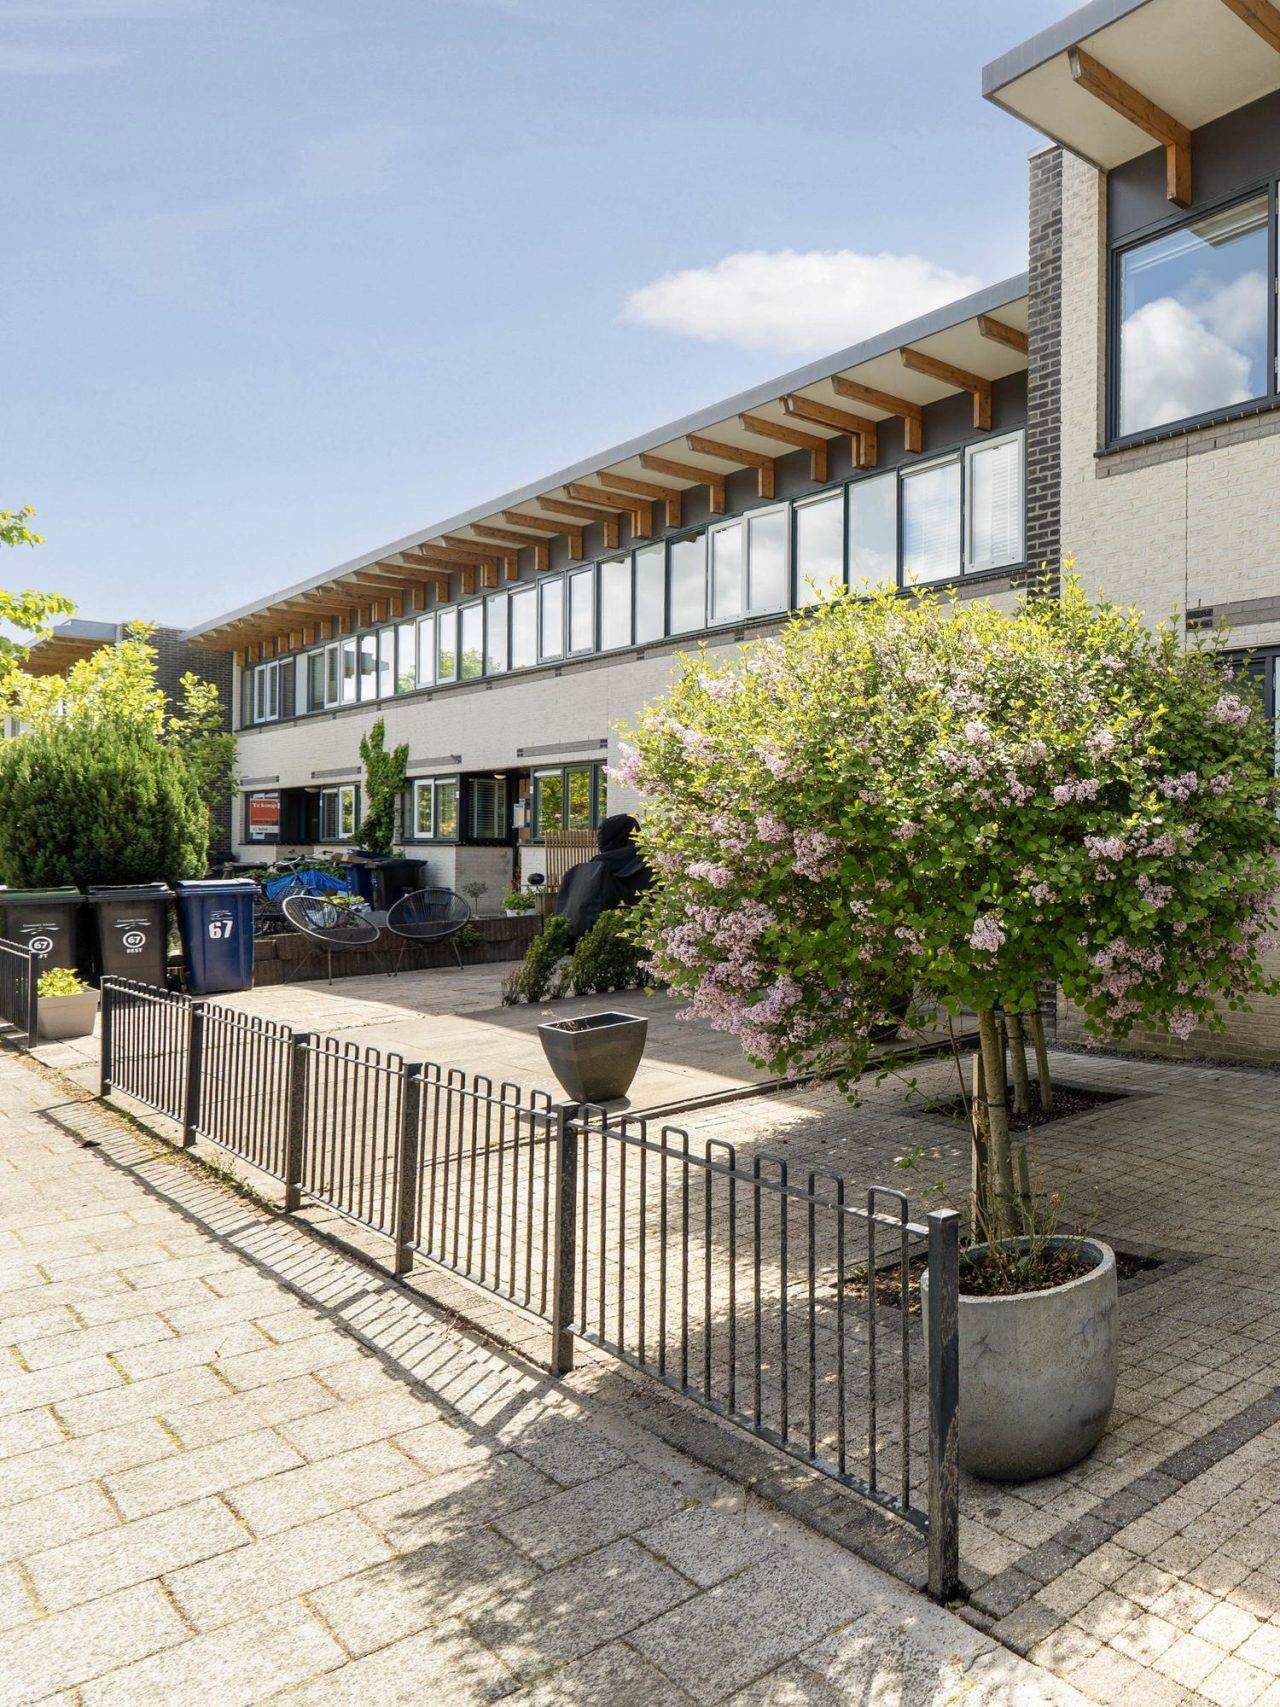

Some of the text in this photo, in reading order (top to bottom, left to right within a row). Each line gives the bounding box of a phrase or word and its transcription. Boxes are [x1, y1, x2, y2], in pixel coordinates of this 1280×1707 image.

[208, 920, 233, 939] 67
[127, 935, 141, 944] 67
[33, 941, 48, 949] 67
